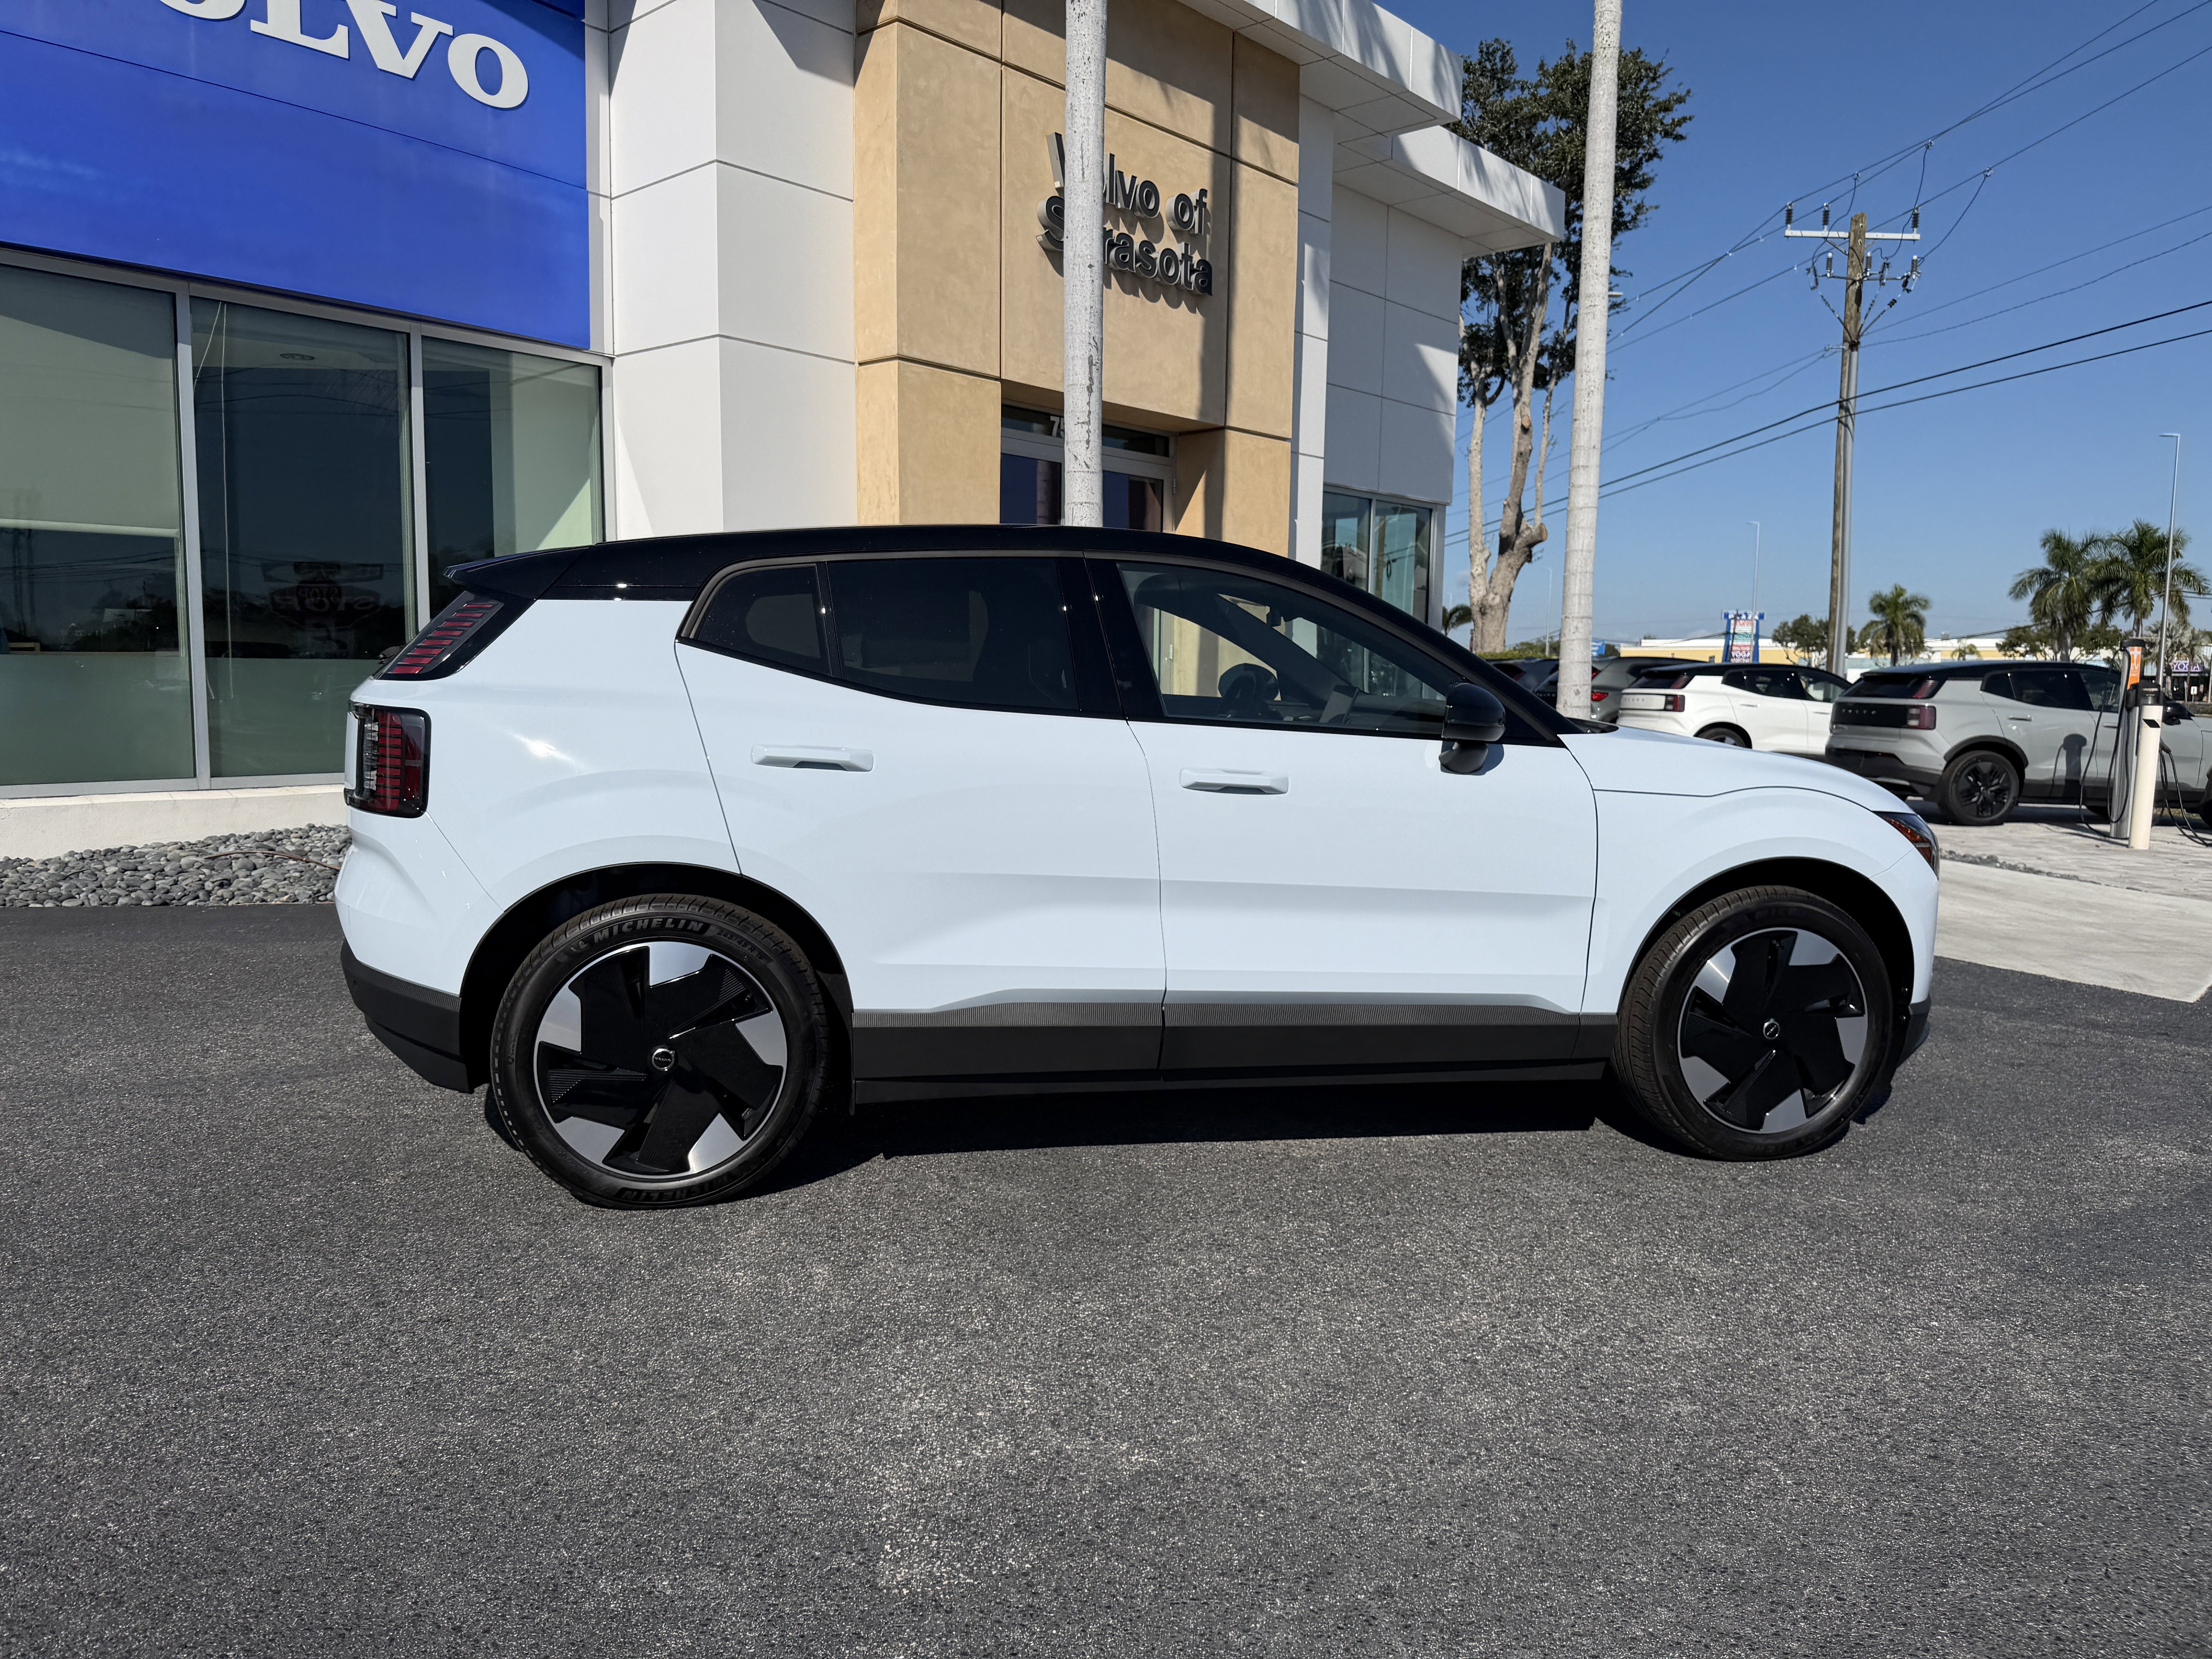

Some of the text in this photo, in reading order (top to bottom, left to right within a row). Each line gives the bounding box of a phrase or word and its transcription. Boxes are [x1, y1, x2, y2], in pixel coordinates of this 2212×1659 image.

[160, 0, 529, 109] LVO
[1036, 195, 1213, 297] Srasota
[1166, 188, 1208, 235] of
[593, 918, 704, 943] MICHELIN
